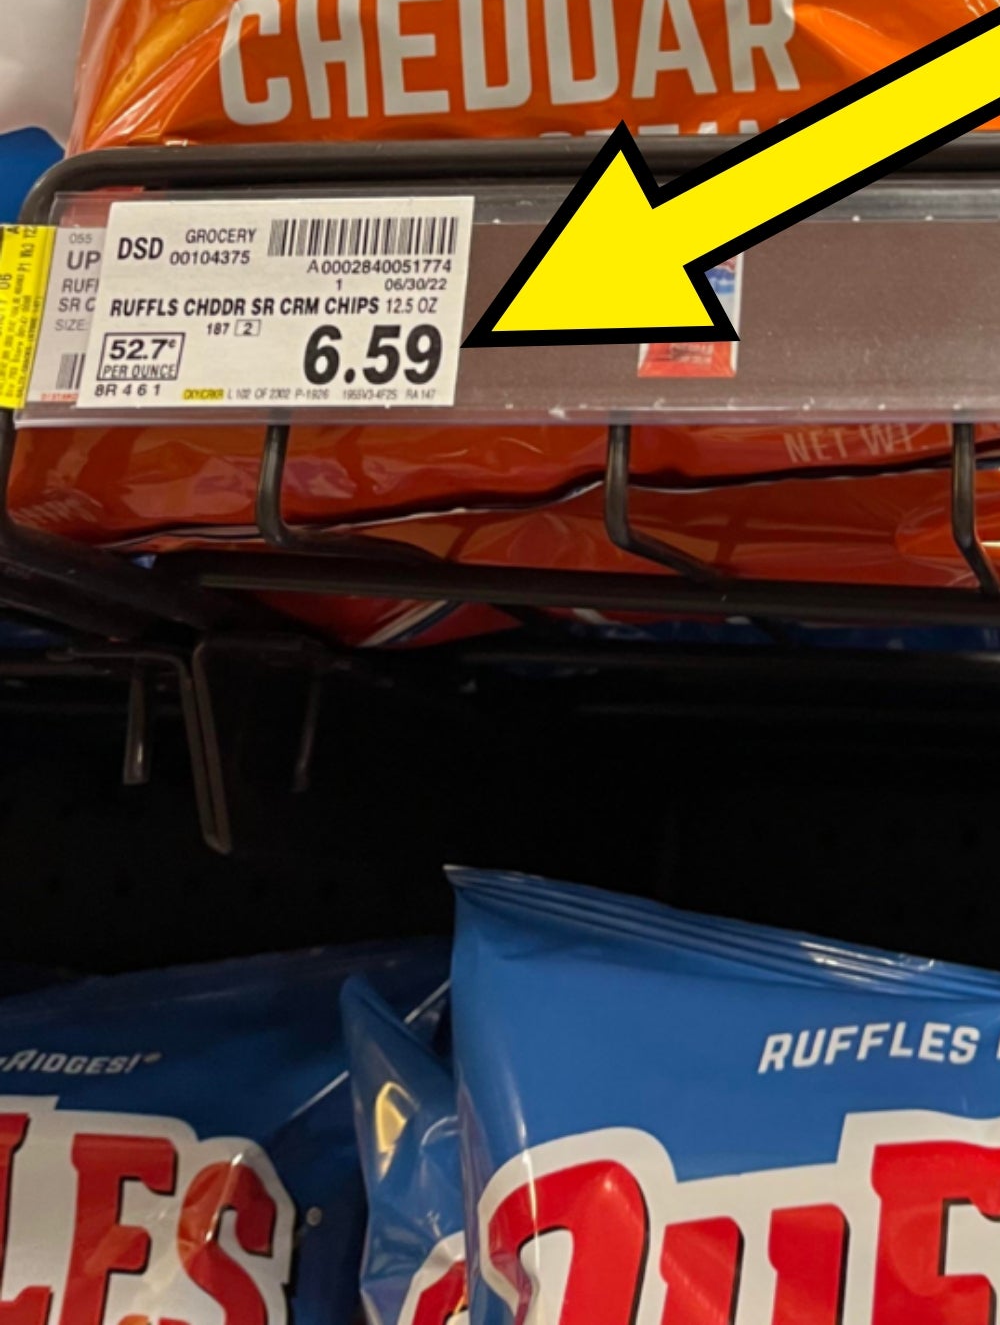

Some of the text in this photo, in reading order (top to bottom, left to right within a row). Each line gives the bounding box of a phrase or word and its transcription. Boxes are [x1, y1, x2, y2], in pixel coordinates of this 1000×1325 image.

[117, 228, 257, 261] DSD GROCERY
[169, 250, 252, 266] 00104375
[306, 258, 453, 276] A0002840051774
[335, 277, 448, 292] 1 06/30/22
[57, 297, 81, 314] SR
[109, 296, 438, 317] RUFFLS CHDDR SR CRM CHIPS 12.5 OZ
[206, 322, 230, 336] 187
[302, 323, 443, 386] 6.59
[103, 364, 176, 380] PER OUNCE
[123, 384, 133, 396] 4
[137, 384, 148, 396] 6
[153, 384, 162, 396] 1
[783, 428, 853, 463] NET
[757, 1020, 982, 1074] RUFFLES
[0, 1048, 142, 1074] RIDGES!
